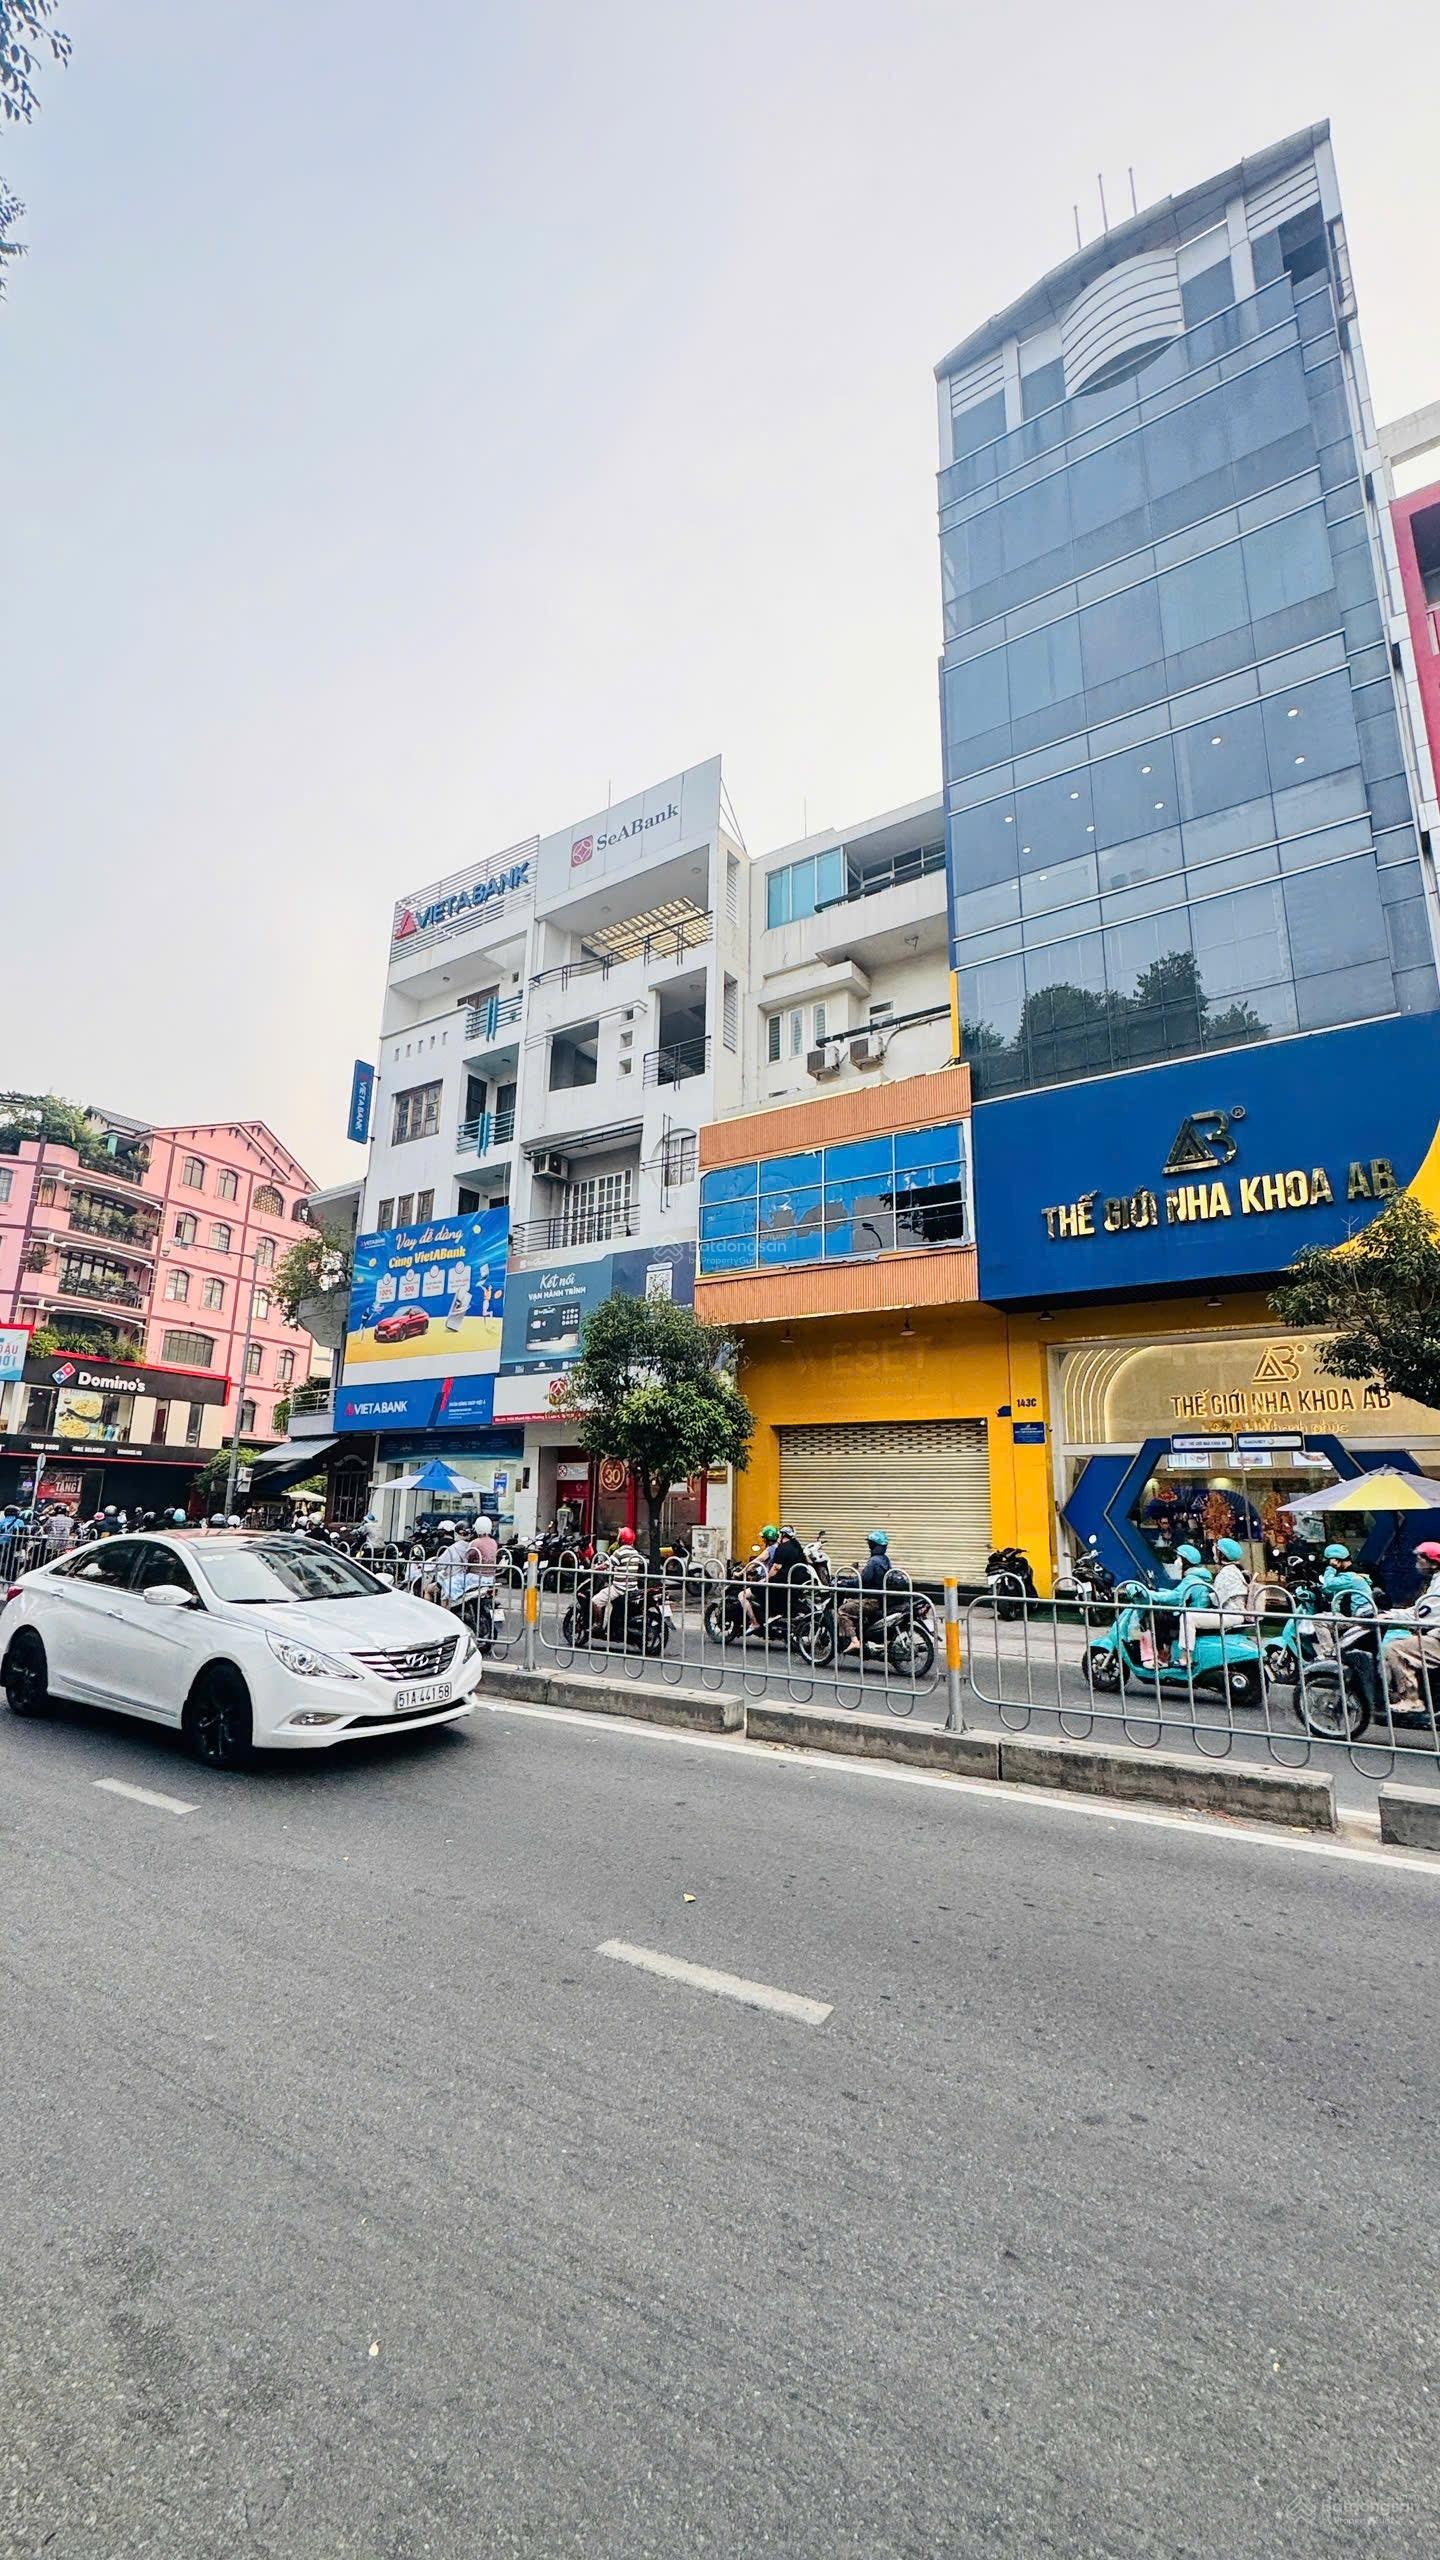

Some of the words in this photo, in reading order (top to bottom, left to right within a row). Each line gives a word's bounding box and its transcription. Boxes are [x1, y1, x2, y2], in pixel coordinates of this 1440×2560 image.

[597, 803, 679, 851] SeABank
[415, 861, 529, 929] VIETABANK
[355, 1081, 368, 1131] VIETABANK
[1041, 1190, 1100, 1239] THẾ
[1103, 1185, 1159, 1232] GIỚI
[1166, 1181, 1232, 1224] NHA
[1239, 1167, 1334, 1214] KHOA
[1347, 1158, 1398, 1200] AB
[395, 1232, 418, 1251] Vay
[419, 1227, 434, 1244] dễ
[434, 1224, 464, 1243] dàng
[388, 1256, 413, 1269] Cùng
[414, 1245, 466, 1264] VietABank
[77, 1371, 146, 1393] Domino's
[354, 1400, 409, 1416] VIETABANK
[1016, 1398, 1037, 1408] 143C
[1171, 1388, 1209, 1418] THẾ
[1211, 1388, 1248, 1417] GIỚI
[1252, 1391, 1293, 1416] NHA
[1298, 1388, 1354, 1413] KHOA
[1363, 1387, 1393, 1412] AB
[604, 1468, 621, 1484] 30
